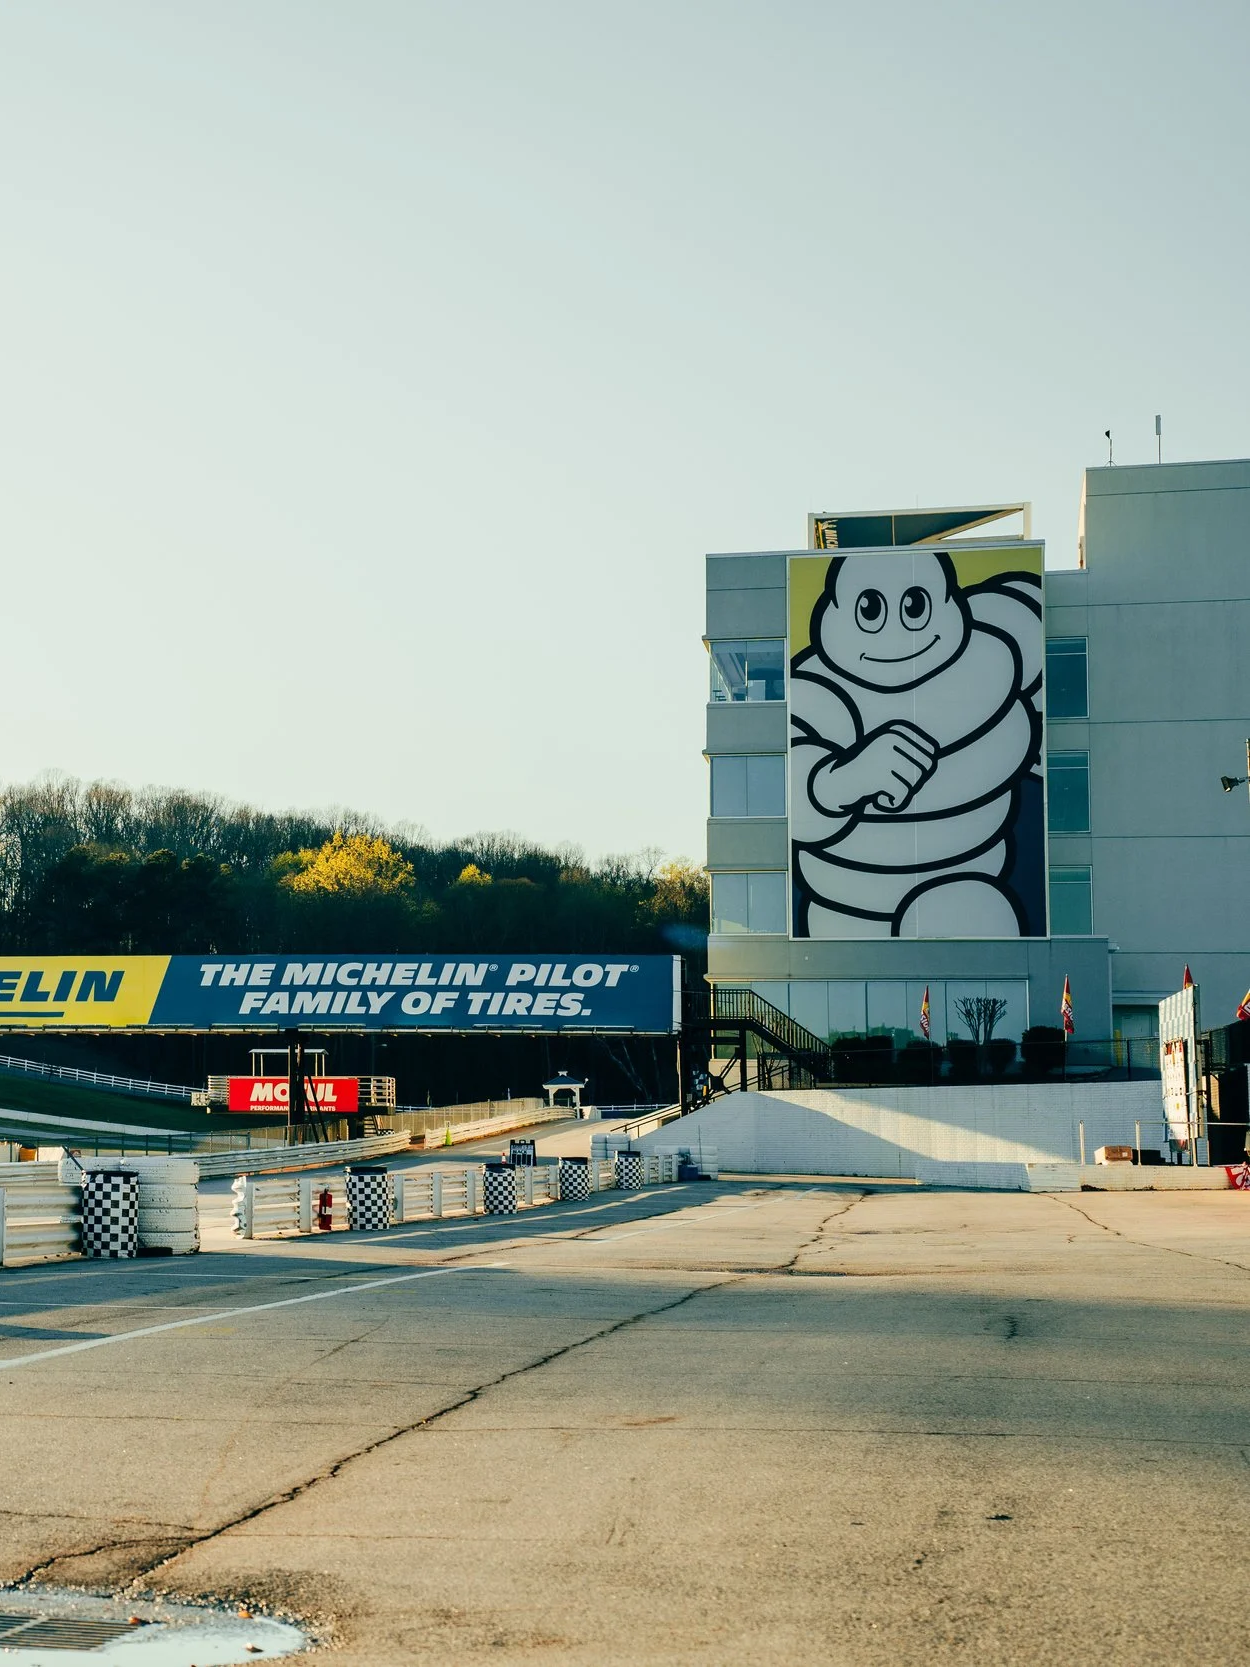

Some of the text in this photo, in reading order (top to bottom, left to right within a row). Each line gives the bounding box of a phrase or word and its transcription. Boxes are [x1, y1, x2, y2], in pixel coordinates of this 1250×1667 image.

[200, 963, 277, 987] THE
[238, 991, 592, 1017] FAMILY OF TIRES.
[250, 1082, 337, 1102] MOUL
